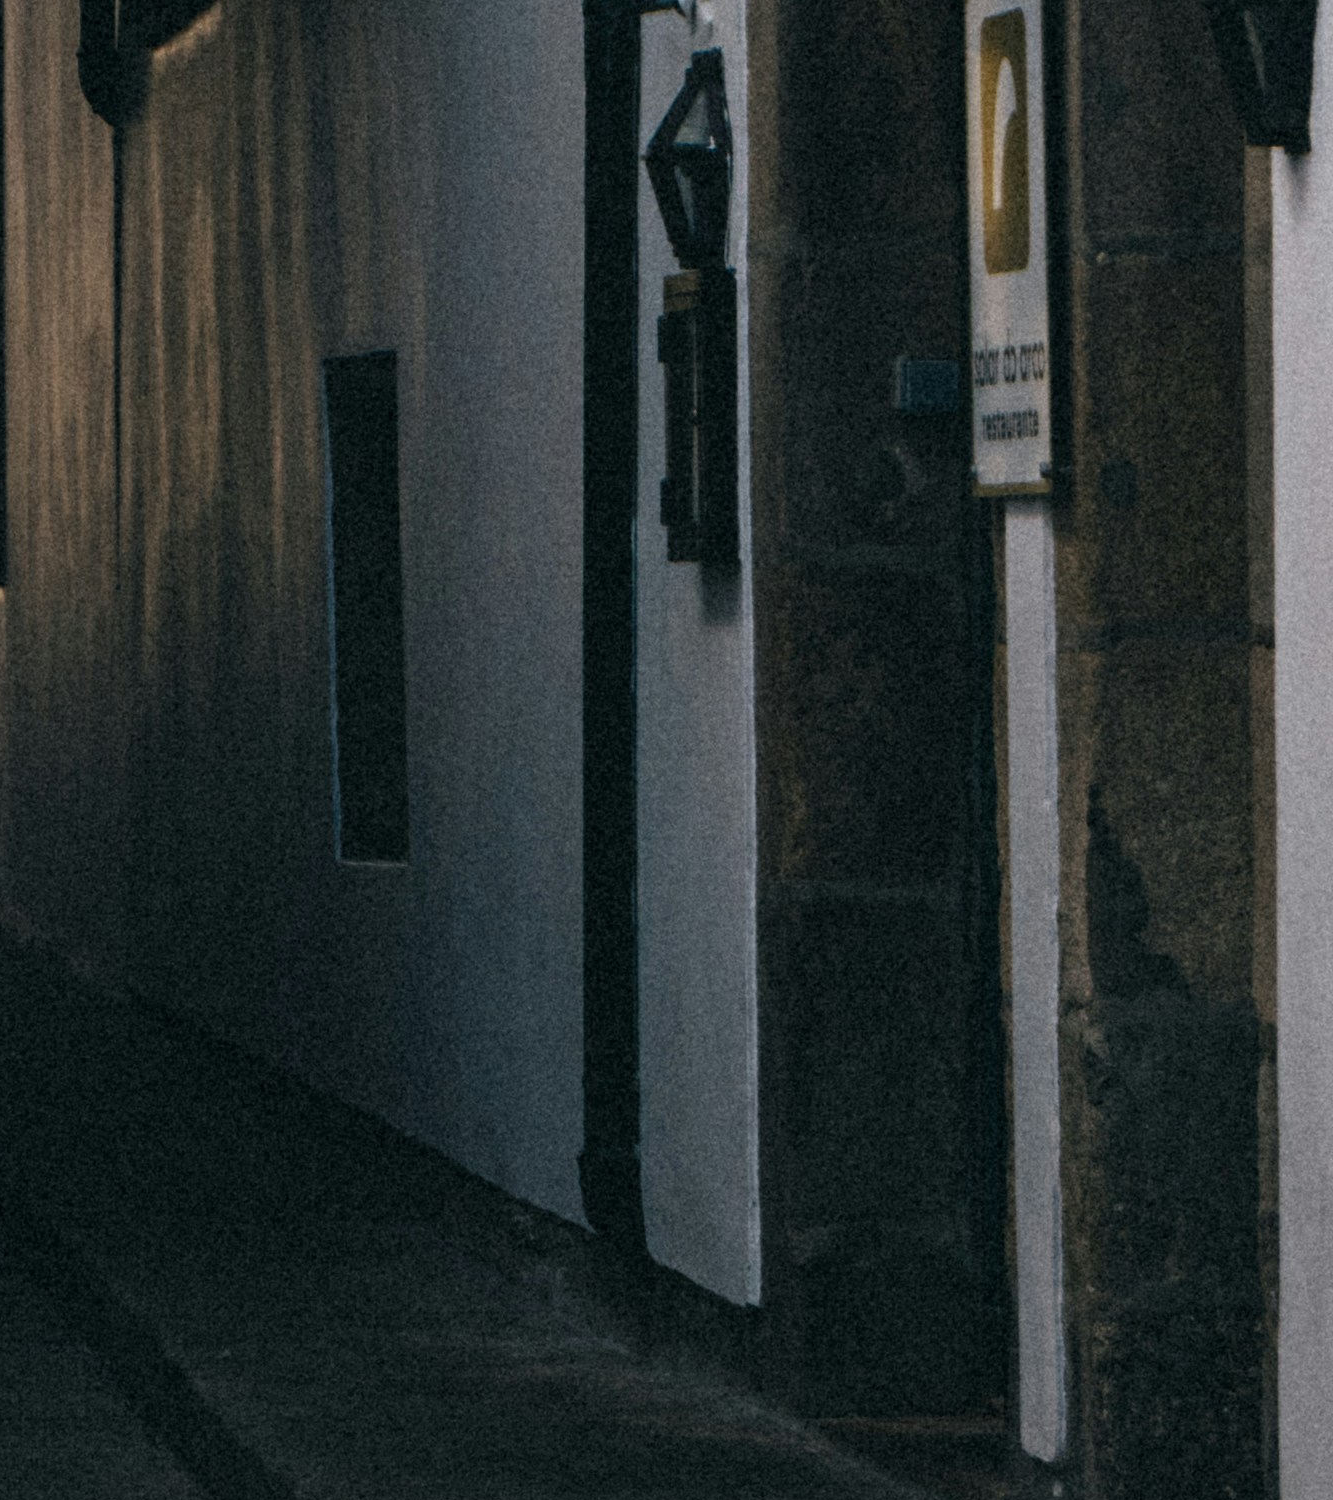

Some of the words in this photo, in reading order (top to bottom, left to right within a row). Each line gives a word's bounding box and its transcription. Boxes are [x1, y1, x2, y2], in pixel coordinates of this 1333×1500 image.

[974, 332, 999, 387] solar
[1019, 341, 1045, 382] arco
[982, 408, 1039, 441] restaurante
